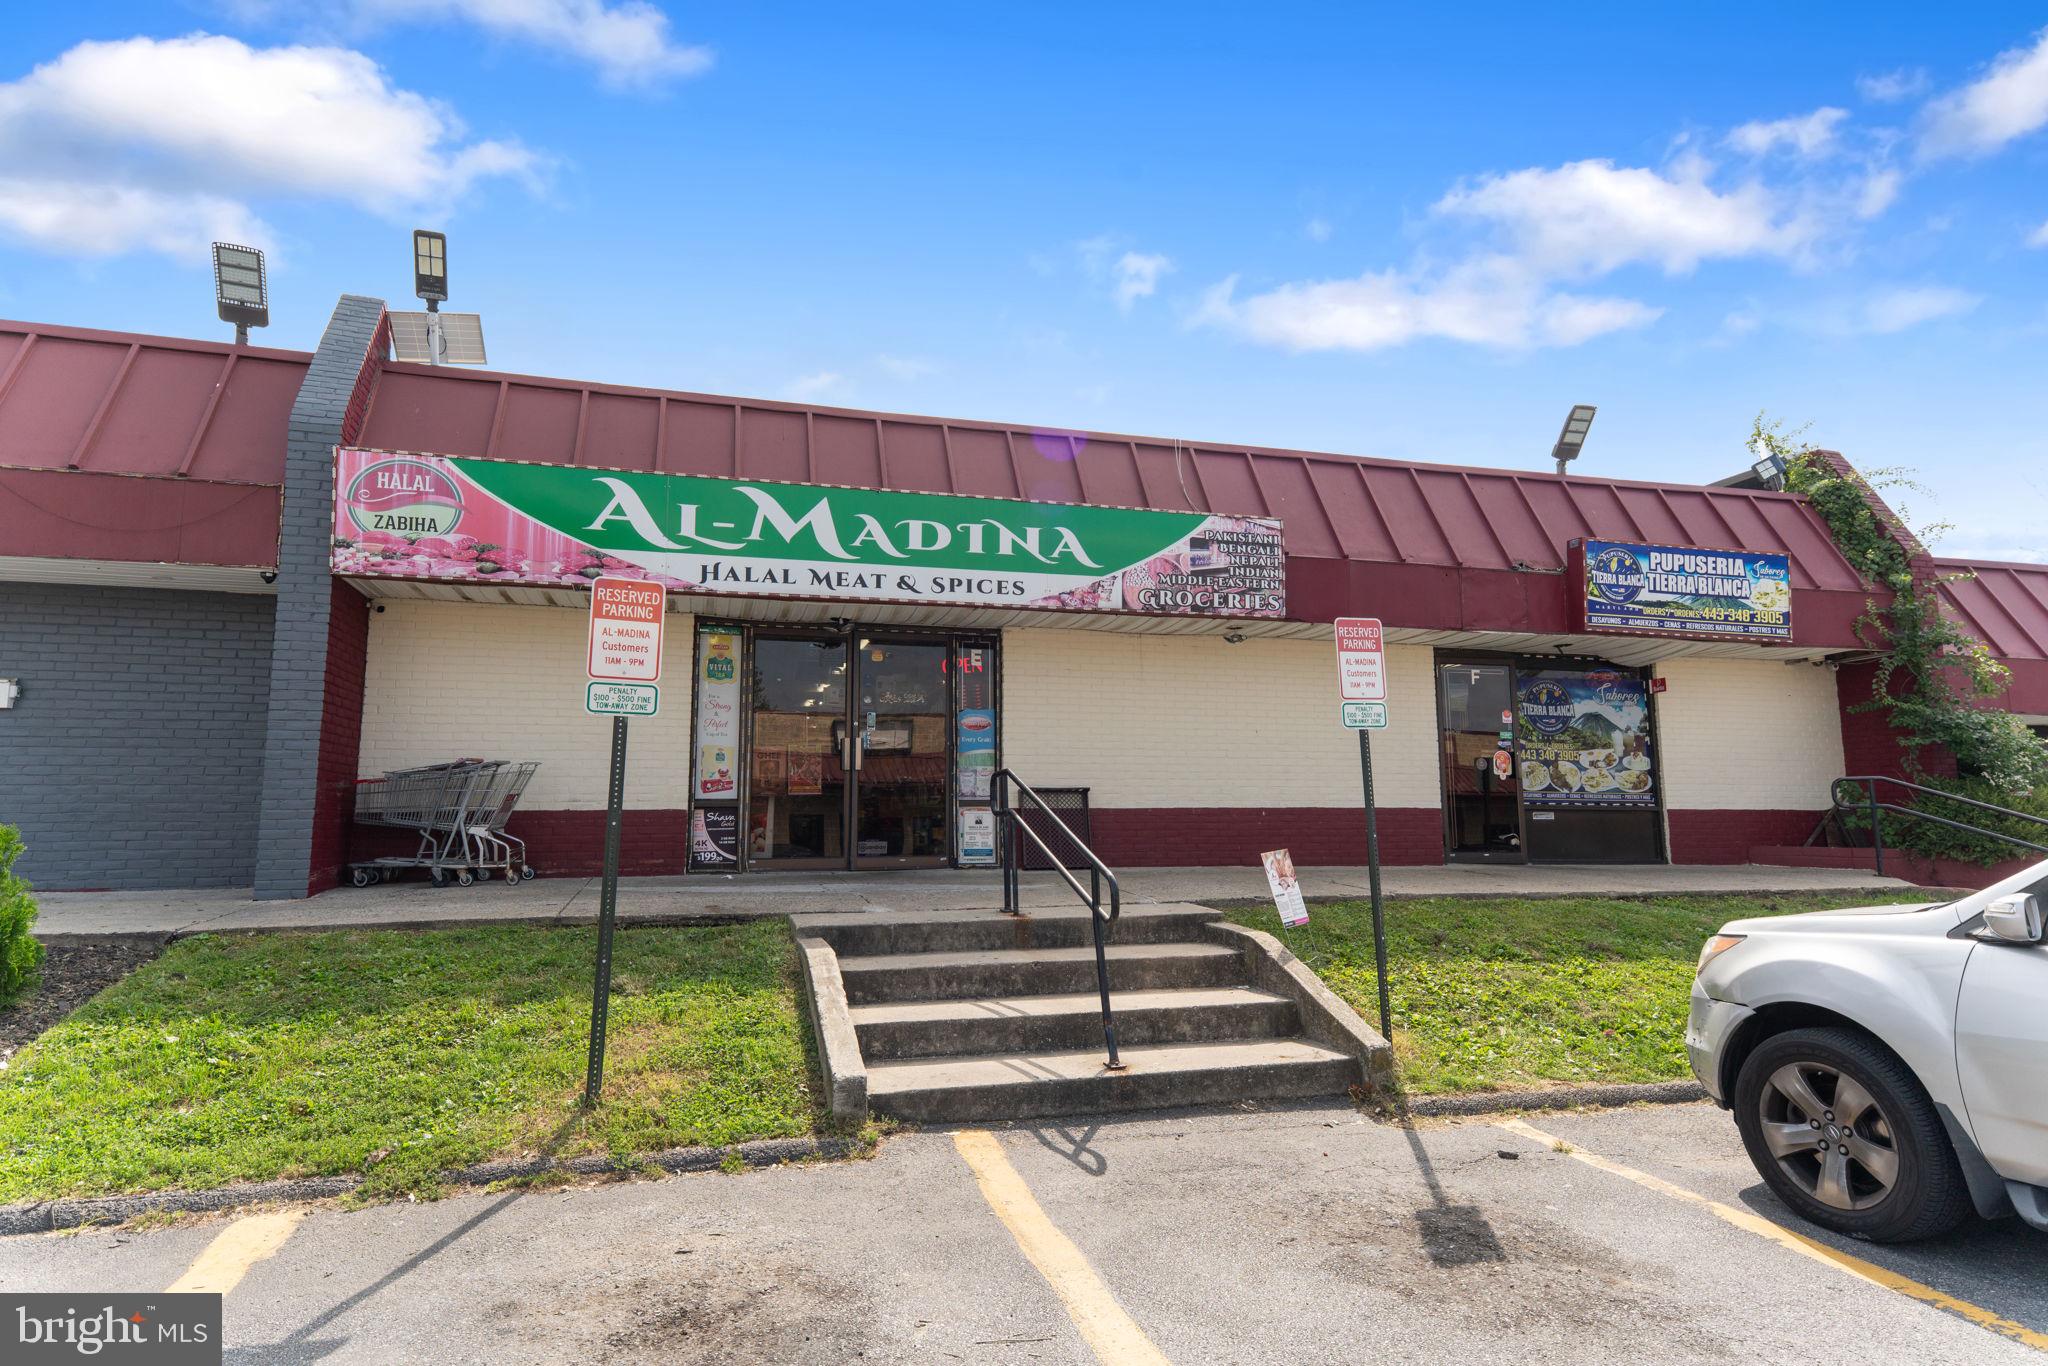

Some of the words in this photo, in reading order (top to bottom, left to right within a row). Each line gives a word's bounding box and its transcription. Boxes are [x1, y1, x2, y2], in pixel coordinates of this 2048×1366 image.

[377, 471, 434, 492] HALAL
[374, 514, 438, 533] ZABIHA
[582, 476, 1104, 568] AL-MADINA
[1204, 530, 1280, 545] PAKISTANI
[1218, 543, 1280, 556] BENGALI
[1227, 554, 1280, 568] NEPALI
[1650, 552, 1746, 577] PUPUSERIA
[1227, 565, 1280, 579] INDIAN
[1592, 570, 1617, 585] TIERRA
[1618, 574, 1645, 587] BLANCA
[699, 563, 798, 586] HALAL
[808, 568, 887, 591] MEAT
[896, 575, 923, 594] &
[930, 574, 1026, 597] SPICES
[1158, 572, 1214, 590] MIDDLE
[1214, 576, 1280, 591] EASTERN
[1646, 572, 1696, 596] TIERRA
[1698, 576, 1752, 598] BLANCA
[597, 588, 660, 605] RESERVED
[1138, 588, 1281, 612] GROCERIES
[602, 603, 654, 620] PARKING
[1643, 607, 1665, 616] ORDERS
[1702, 607, 1724, 620] 443
[1728, 608, 1750, 622] 348
[1754, 610, 1783, 624] 3905
[602, 627, 650, 639] AL-MADINA
[1338, 627, 1379, 638] RESERVED
[1664, 620, 1680, 628] CENAS
[1686, 622, 1714, 630] REFRESCOS
[1715, 624, 1743, 632] NATURALES
[602, 642, 649, 653] Customers
[1343, 639, 1376, 650] PARKING
[604, 657, 621, 665] 11AM
[629, 658, 644, 666] 9PM
[971, 649, 982, 666] E
[1346, 658, 1376, 666] AL-MADINA
[1471, 669, 1480, 684] F
[609, 687, 638, 695] PENALTY
[1532, 682, 1562, 694] PUPUSERIA
[1593, 682, 1640, 706] Sabores
[595, 702, 628, 710] TOW-AWAY
[631, 703, 648, 711] ZONE
[637, 695, 652, 704] FINE
[705, 700, 731, 712] Strong
[1523, 703, 1546, 716] TIERRA
[1549, 705, 1575, 717] BLANCA
[1521, 750, 1536, 760] 443
[1539, 750, 1555, 760] 348
[1558, 751, 1579, 761] 3905
[706, 812, 735, 822] Shava
